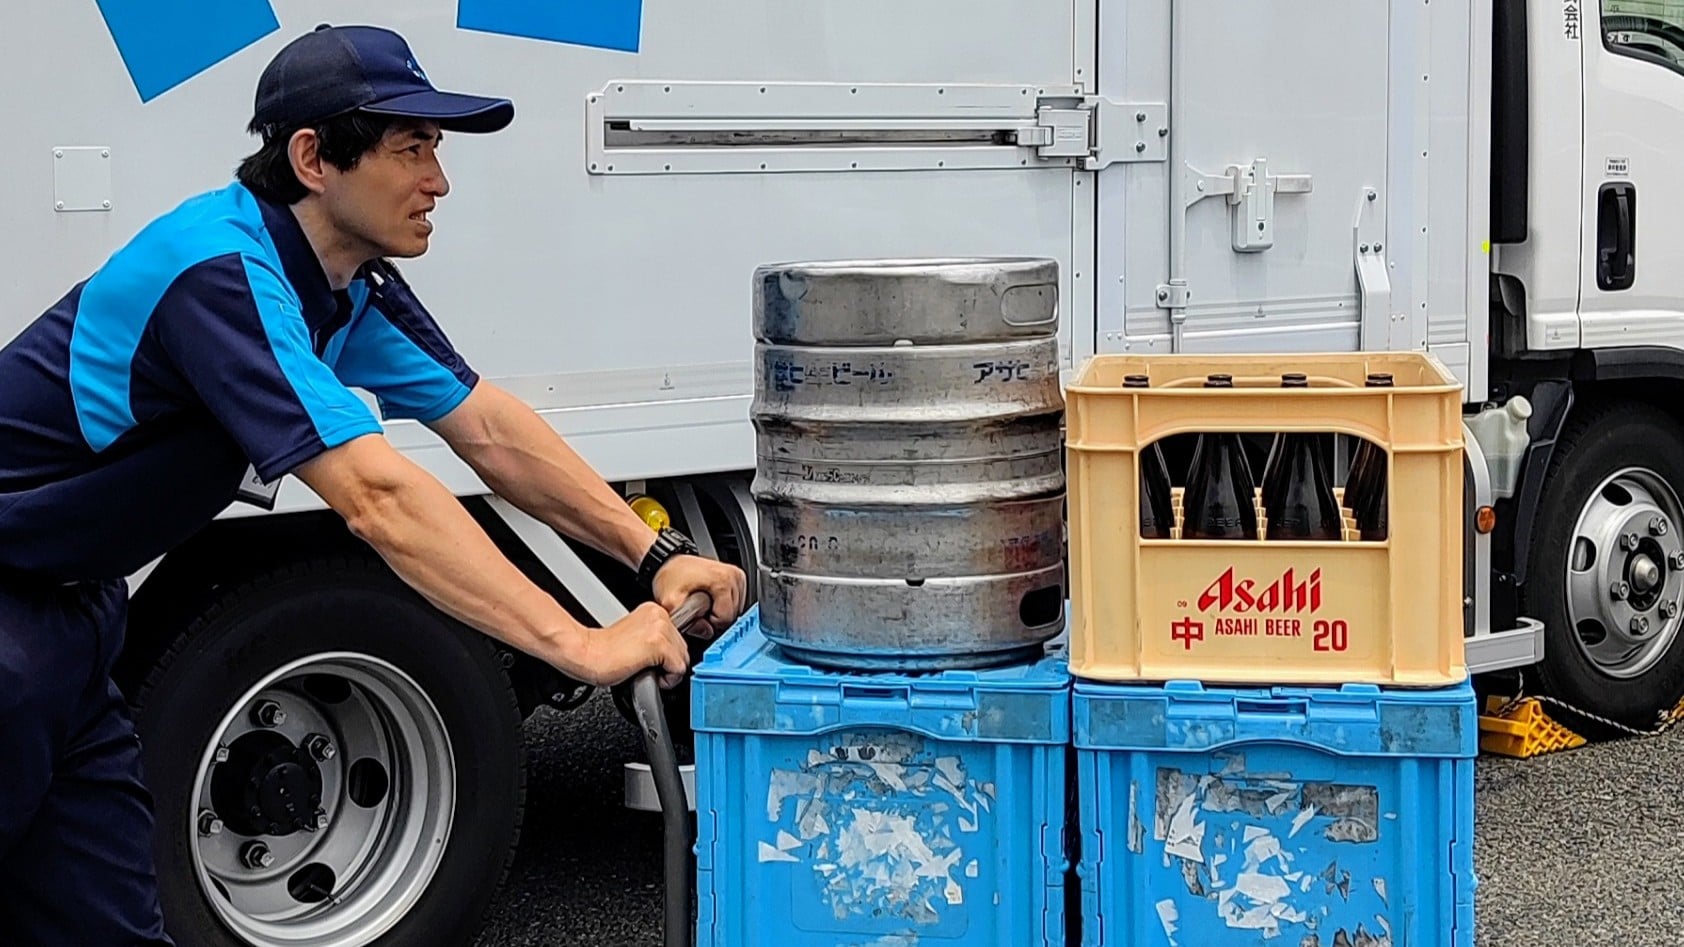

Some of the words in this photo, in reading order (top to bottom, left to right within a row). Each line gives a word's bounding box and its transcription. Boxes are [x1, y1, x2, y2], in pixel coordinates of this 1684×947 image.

[1564, 0, 1579, 40] 会社
[1197, 565, 1322, 614] Asahi
[1171, 616, 1204, 650] 中
[1215, 618, 1258, 636] ASAHI
[1265, 618, 1301, 637] BEER
[1313, 620, 1348, 652] 20
